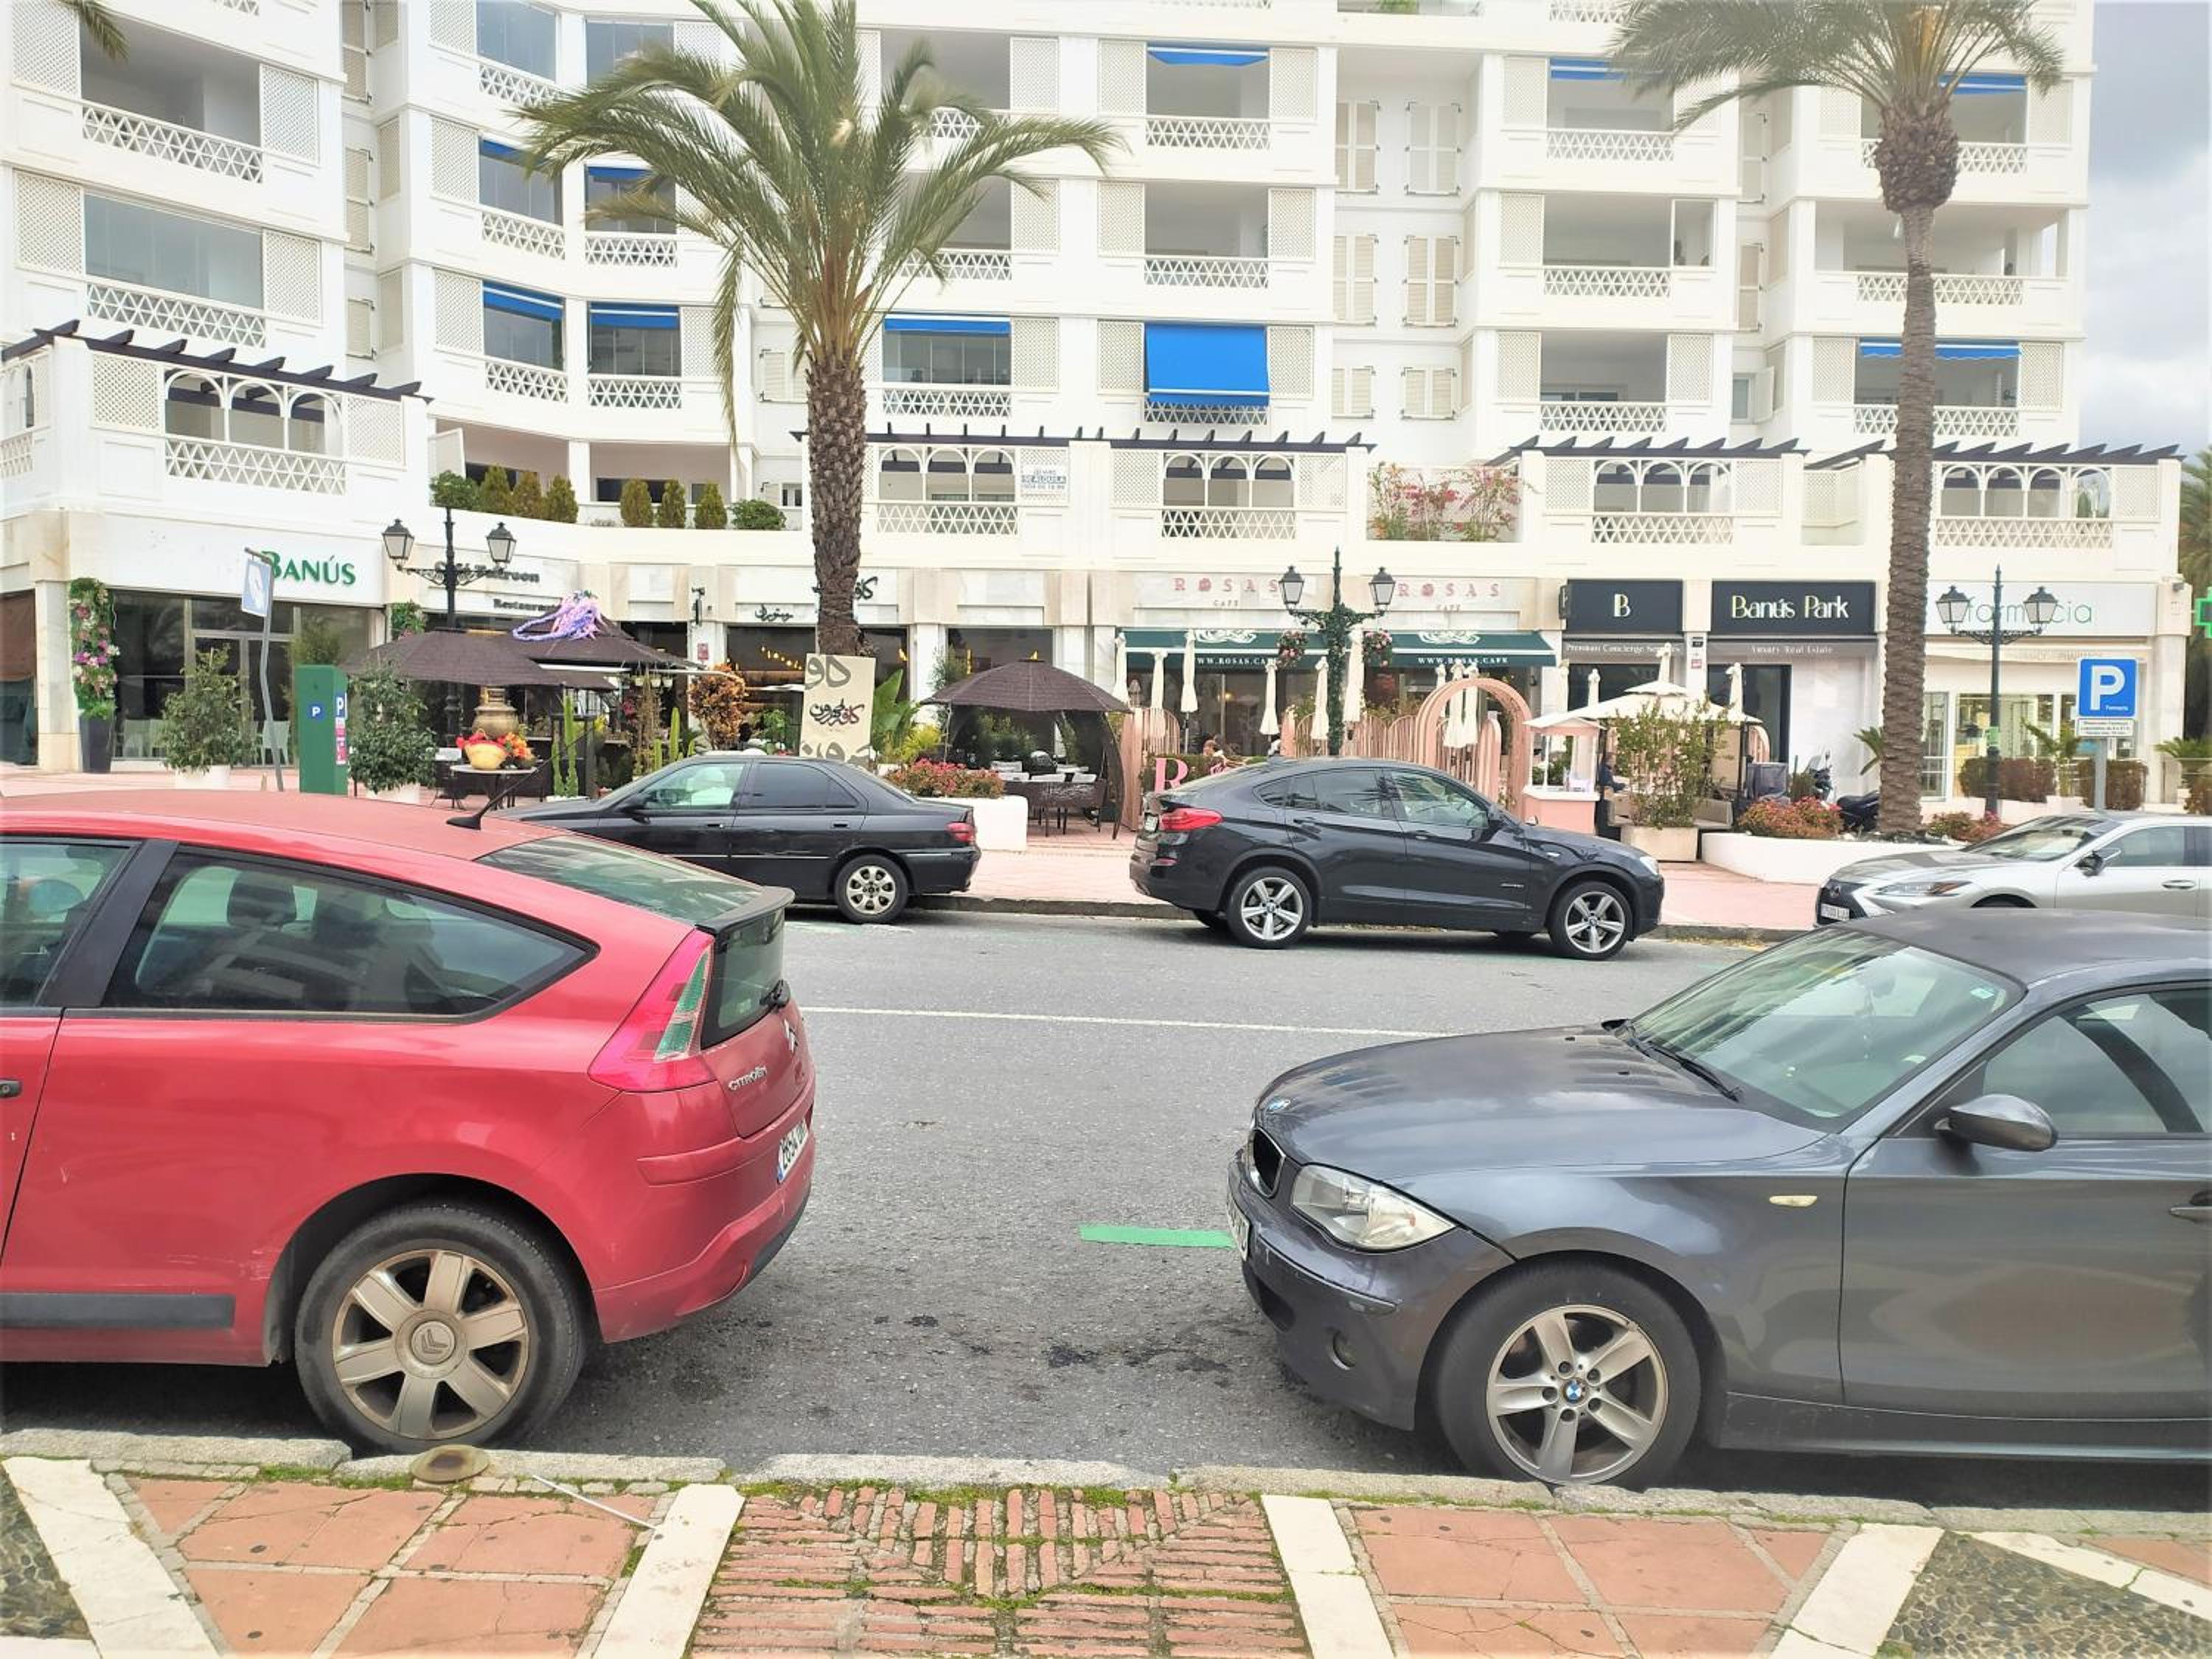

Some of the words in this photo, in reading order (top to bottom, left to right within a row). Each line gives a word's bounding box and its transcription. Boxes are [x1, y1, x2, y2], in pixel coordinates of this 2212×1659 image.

[262, 551, 356, 585] BANÚS
[1174, 578, 1278, 592] ROSAS
[1398, 582, 1500, 597] ROSAS
[1614, 594, 1632, 617] B
[1732, 595, 1795, 618] Banús
[1804, 595, 1849, 618] Park
[2090, 666, 2126, 710] P
[312, 706, 321, 717] P
[337, 697, 344, 716] P
